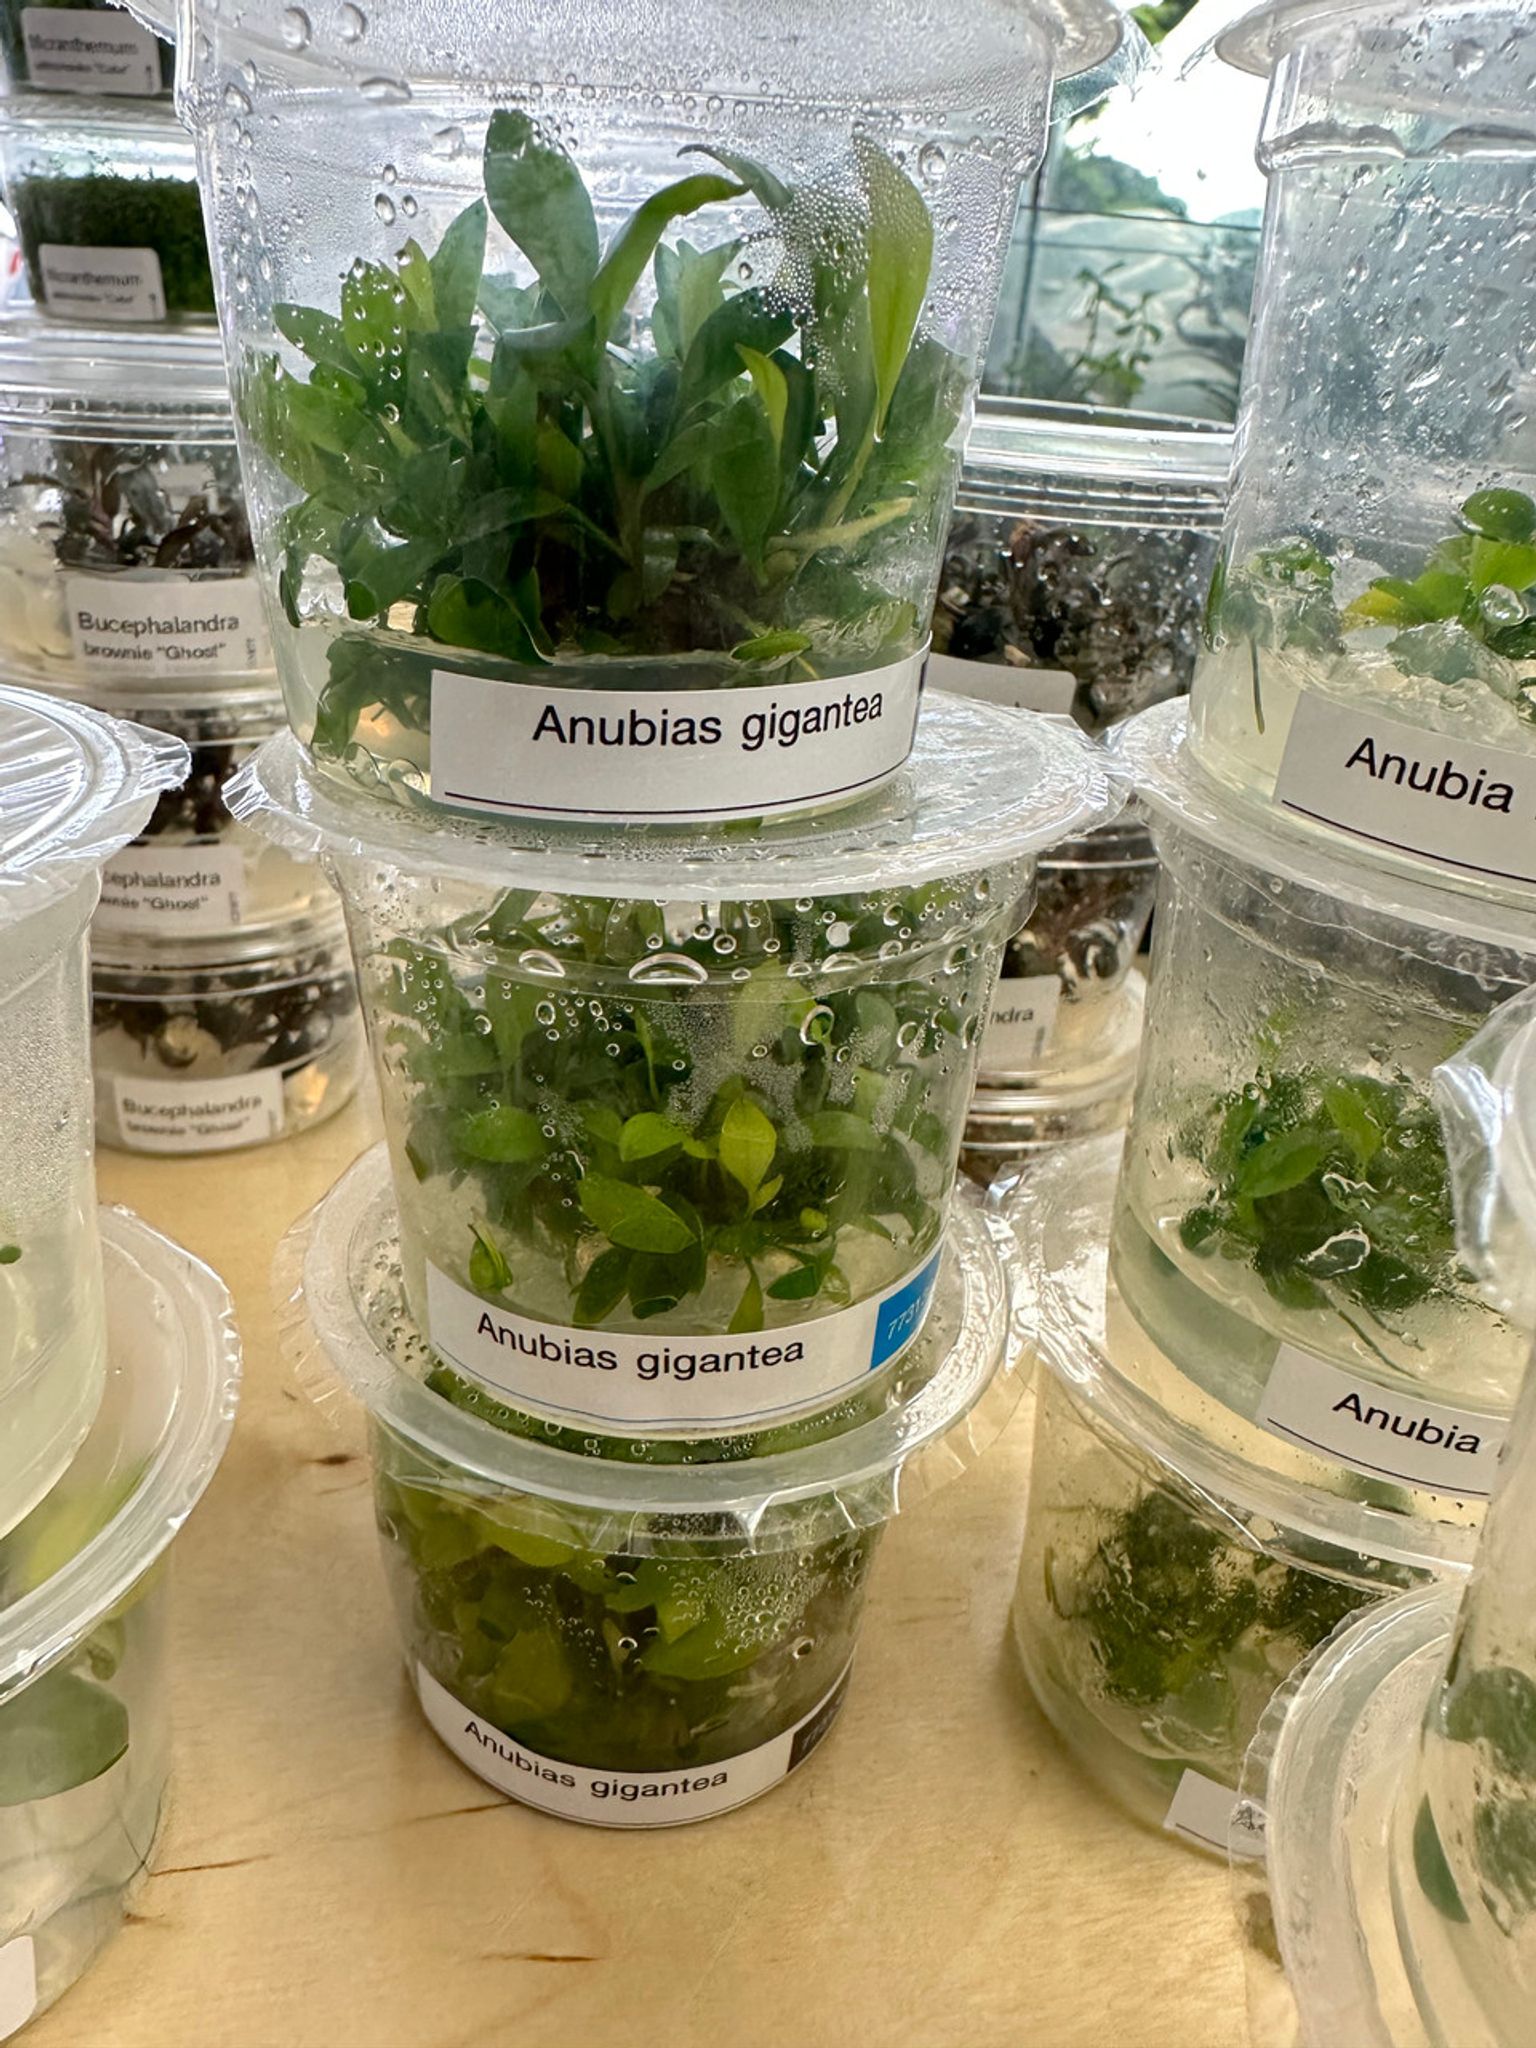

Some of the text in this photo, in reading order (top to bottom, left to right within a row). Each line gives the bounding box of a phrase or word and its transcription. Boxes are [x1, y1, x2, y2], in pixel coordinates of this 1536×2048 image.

[78, 611, 240, 638] Bucephalandra
[84, 641, 153, 660] brownie
[156, 643, 226, 660] "Ghost"
[533, 693, 884, 752] Anubias gigantea
[1345, 737, 1514, 813] Anubia
[143, 896, 209, 911] "Ghost"
[122, 1096, 262, 1120] Bucephalandra
[887, 1295, 926, 1341] 7731
[477, 1311, 805, 1381] Anubias gigantea
[1332, 1393, 1480, 1454] Anubia
[464, 1719, 729, 1801] Anubias gigantea
